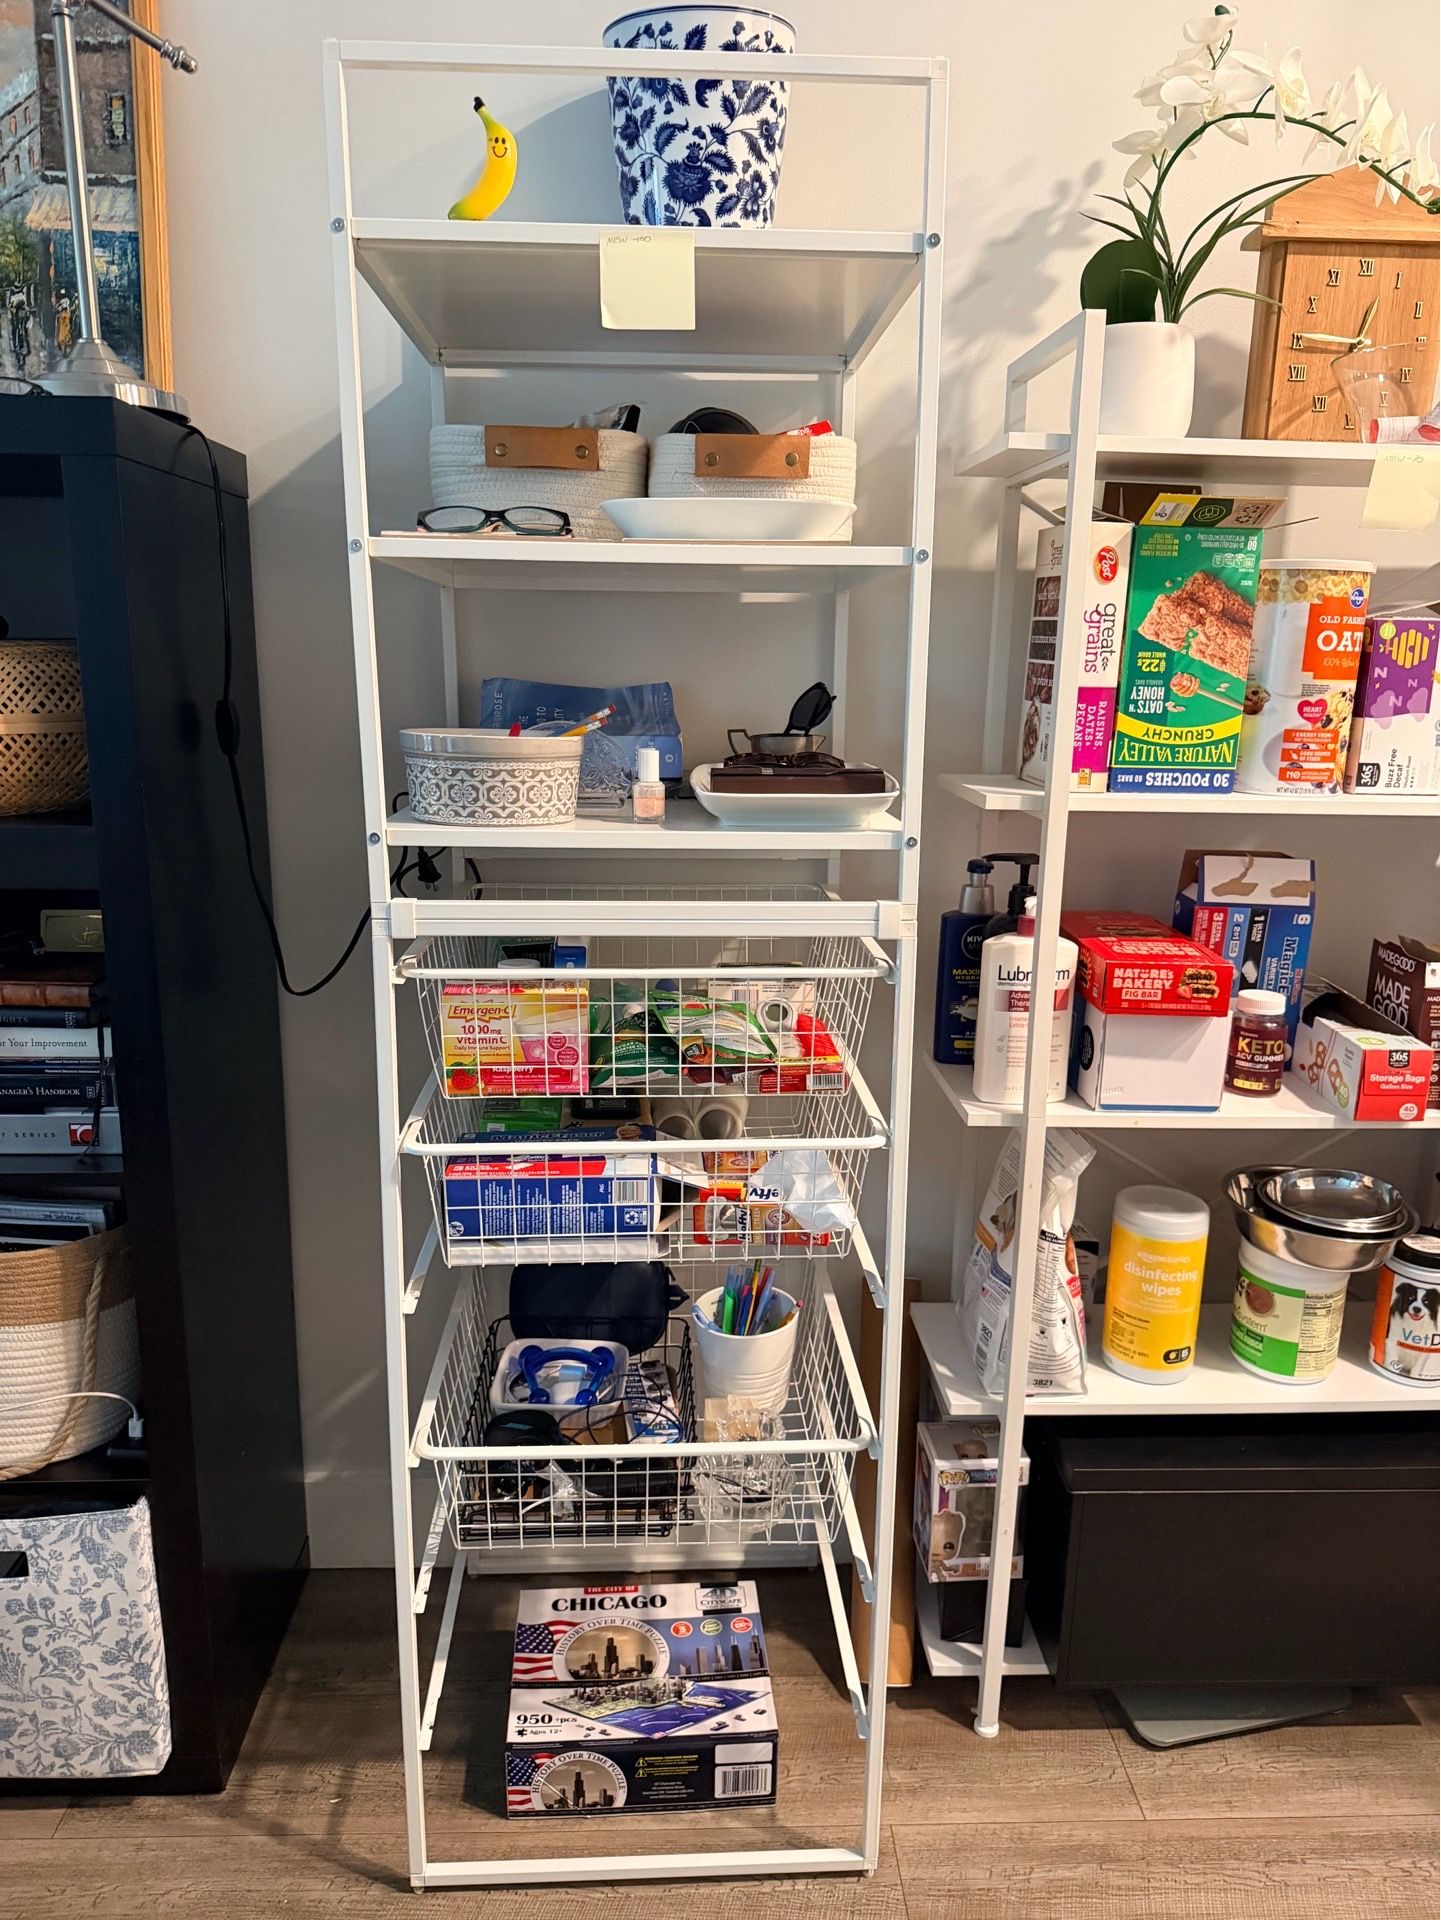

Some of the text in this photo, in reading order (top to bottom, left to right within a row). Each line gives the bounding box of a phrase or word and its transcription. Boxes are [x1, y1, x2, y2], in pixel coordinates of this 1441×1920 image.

[1359, 258, 1375, 276] XII
[1328, 268, 1342, 286] XI
[1288, 364, 1307, 381] VIII
[1312, 395, 1328, 412] VII
[1100, 550, 1117, 580] Post
[1319, 615, 1341, 624] OLD
[1100, 602, 1117, 657] great
[1083, 603, 1103, 674] grains
[1130, 686, 1165, 700] HONEY
[1137, 700, 1163, 714] OATS
[1084, 705, 1097, 740] DATES
[1094, 700, 1107, 750] RAISINS,
[1141, 727, 1214, 741] CRUNCHY
[1118, 738, 1234, 763] NATURE VALLEY
[1361, 762, 1374, 786] 365
[1384, 748, 1398, 788] Buzz Free
[1393, 764, 1403, 788] Decaf
[1117, 772, 1230, 787] 30 POUCHES 60 BARS
[1213, 912, 1224, 921] 3
[1234, 913, 1244, 922] 2
[1297, 913, 1311, 925] 6
[1377, 944, 1415, 973] MADEGOOD
[1112, 978, 1174, 990] BAKERY
[1374, 971, 1411, 1009] MADE
[1124, 990, 1158, 999] FIG BAR
[8, 1038, 28, 1047] Your
[31, 1038, 87, 1050] Improvement
[457, 1036, 507, 1045] Vitamin C
[1237, 1036, 1284, 1056] KETO
[1236, 1051, 1252, 1060] ACV
[1390, 1052, 1408, 1062] 365
[1370, 1074, 1426, 1084] Storage Bags
[36, 1086, 81, 1096] HANDBOOK
[1403, 1105, 1415, 1113] 40
[1124, 1260, 1198, 1282] disinfecting
[1141, 1282, 1182, 1296] wipes
[1032, 1378, 1053, 1386] 3821
[940, 1470, 969, 1486] POP!
[551, 1594, 667, 1612] CHICAGO
[556, 1618, 668, 1657] HISTORY OVER TIME PUZZLE
[516, 1713, 553, 1725] 950
[532, 1752, 626, 1794] HISTORY OVER TIME PUZZLE
